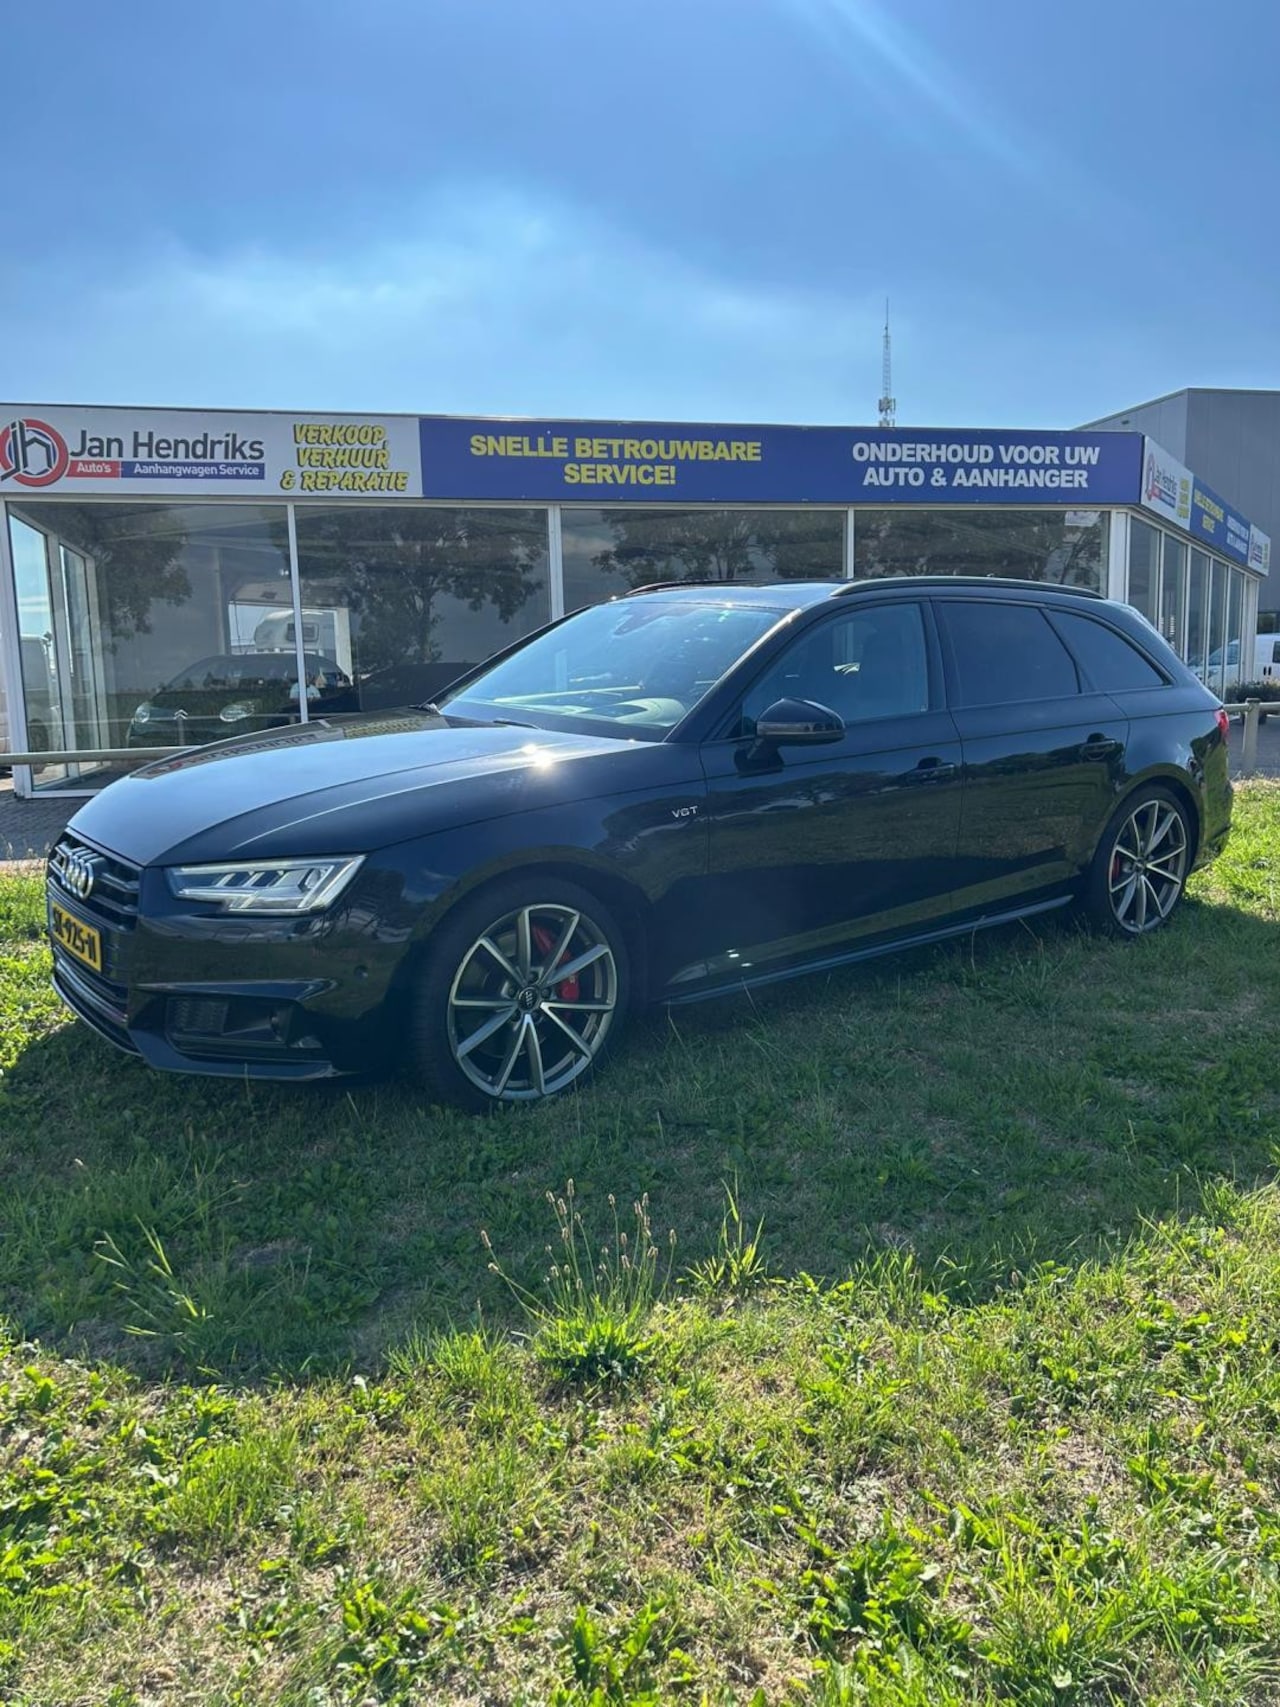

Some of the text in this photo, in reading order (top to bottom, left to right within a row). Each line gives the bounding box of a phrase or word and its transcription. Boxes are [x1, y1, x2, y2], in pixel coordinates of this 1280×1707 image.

[69, 429, 265, 460] Jan Hendriks
[470, 435, 762, 462] SNELLE BETROUWBARE
[852, 442, 1101, 465] ONDERHOUD VOOR UW
[77, 463, 112, 474] Auto's
[296, 446, 390, 469] VERHUUR
[134, 464, 260, 477] Aanhangwagen Service
[280, 470, 410, 492] & REPARATIE
[564, 464, 676, 485] SERVICE!
[863, 467, 1088, 488] AUTO & AANHANGER
